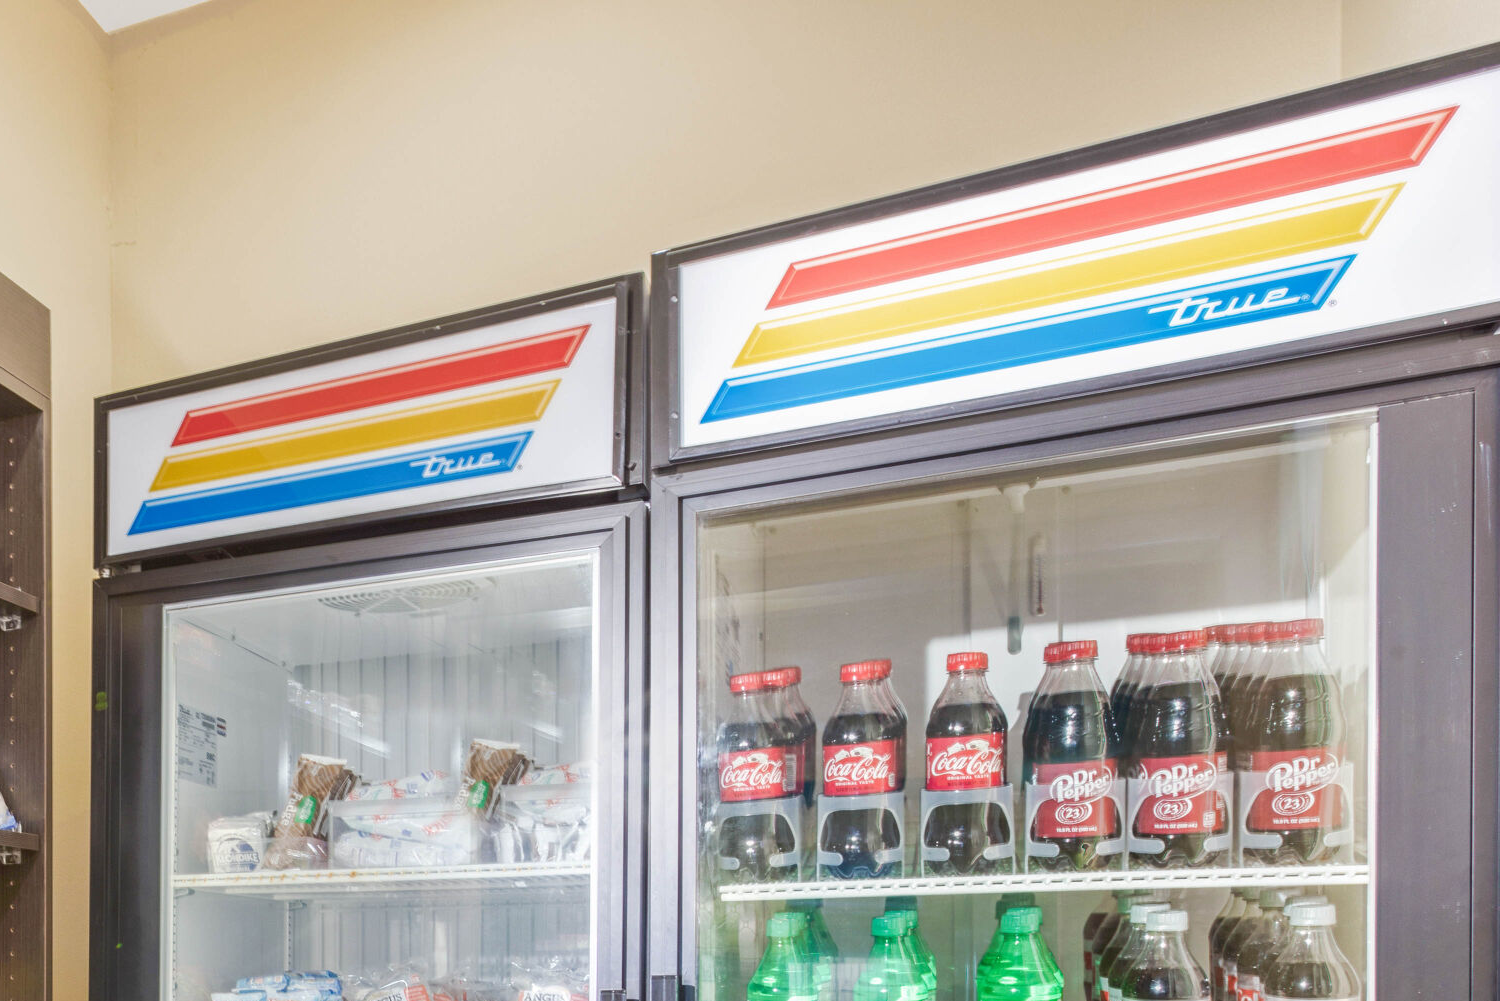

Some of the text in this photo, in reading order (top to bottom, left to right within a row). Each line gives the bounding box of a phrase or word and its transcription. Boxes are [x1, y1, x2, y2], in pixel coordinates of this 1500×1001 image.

[824, 753, 891, 783] Coca-Cola
[931, 747, 1002, 777] Coca-Cola
[1172, 764, 1198, 781] Dr
[1297, 753, 1322, 771] Dr
[721, 760, 783, 788] Coca-Cola
[1073, 769, 1098, 786] Dr
[1153, 770, 1214, 798] Pepper
[1268, 760, 1338, 792] Pepper
[1055, 774, 1111, 802] Pepper
[1065, 808, 1080, 819] 23
[1163, 804, 1178, 815] 23
[1282, 798, 1302, 810] 23
